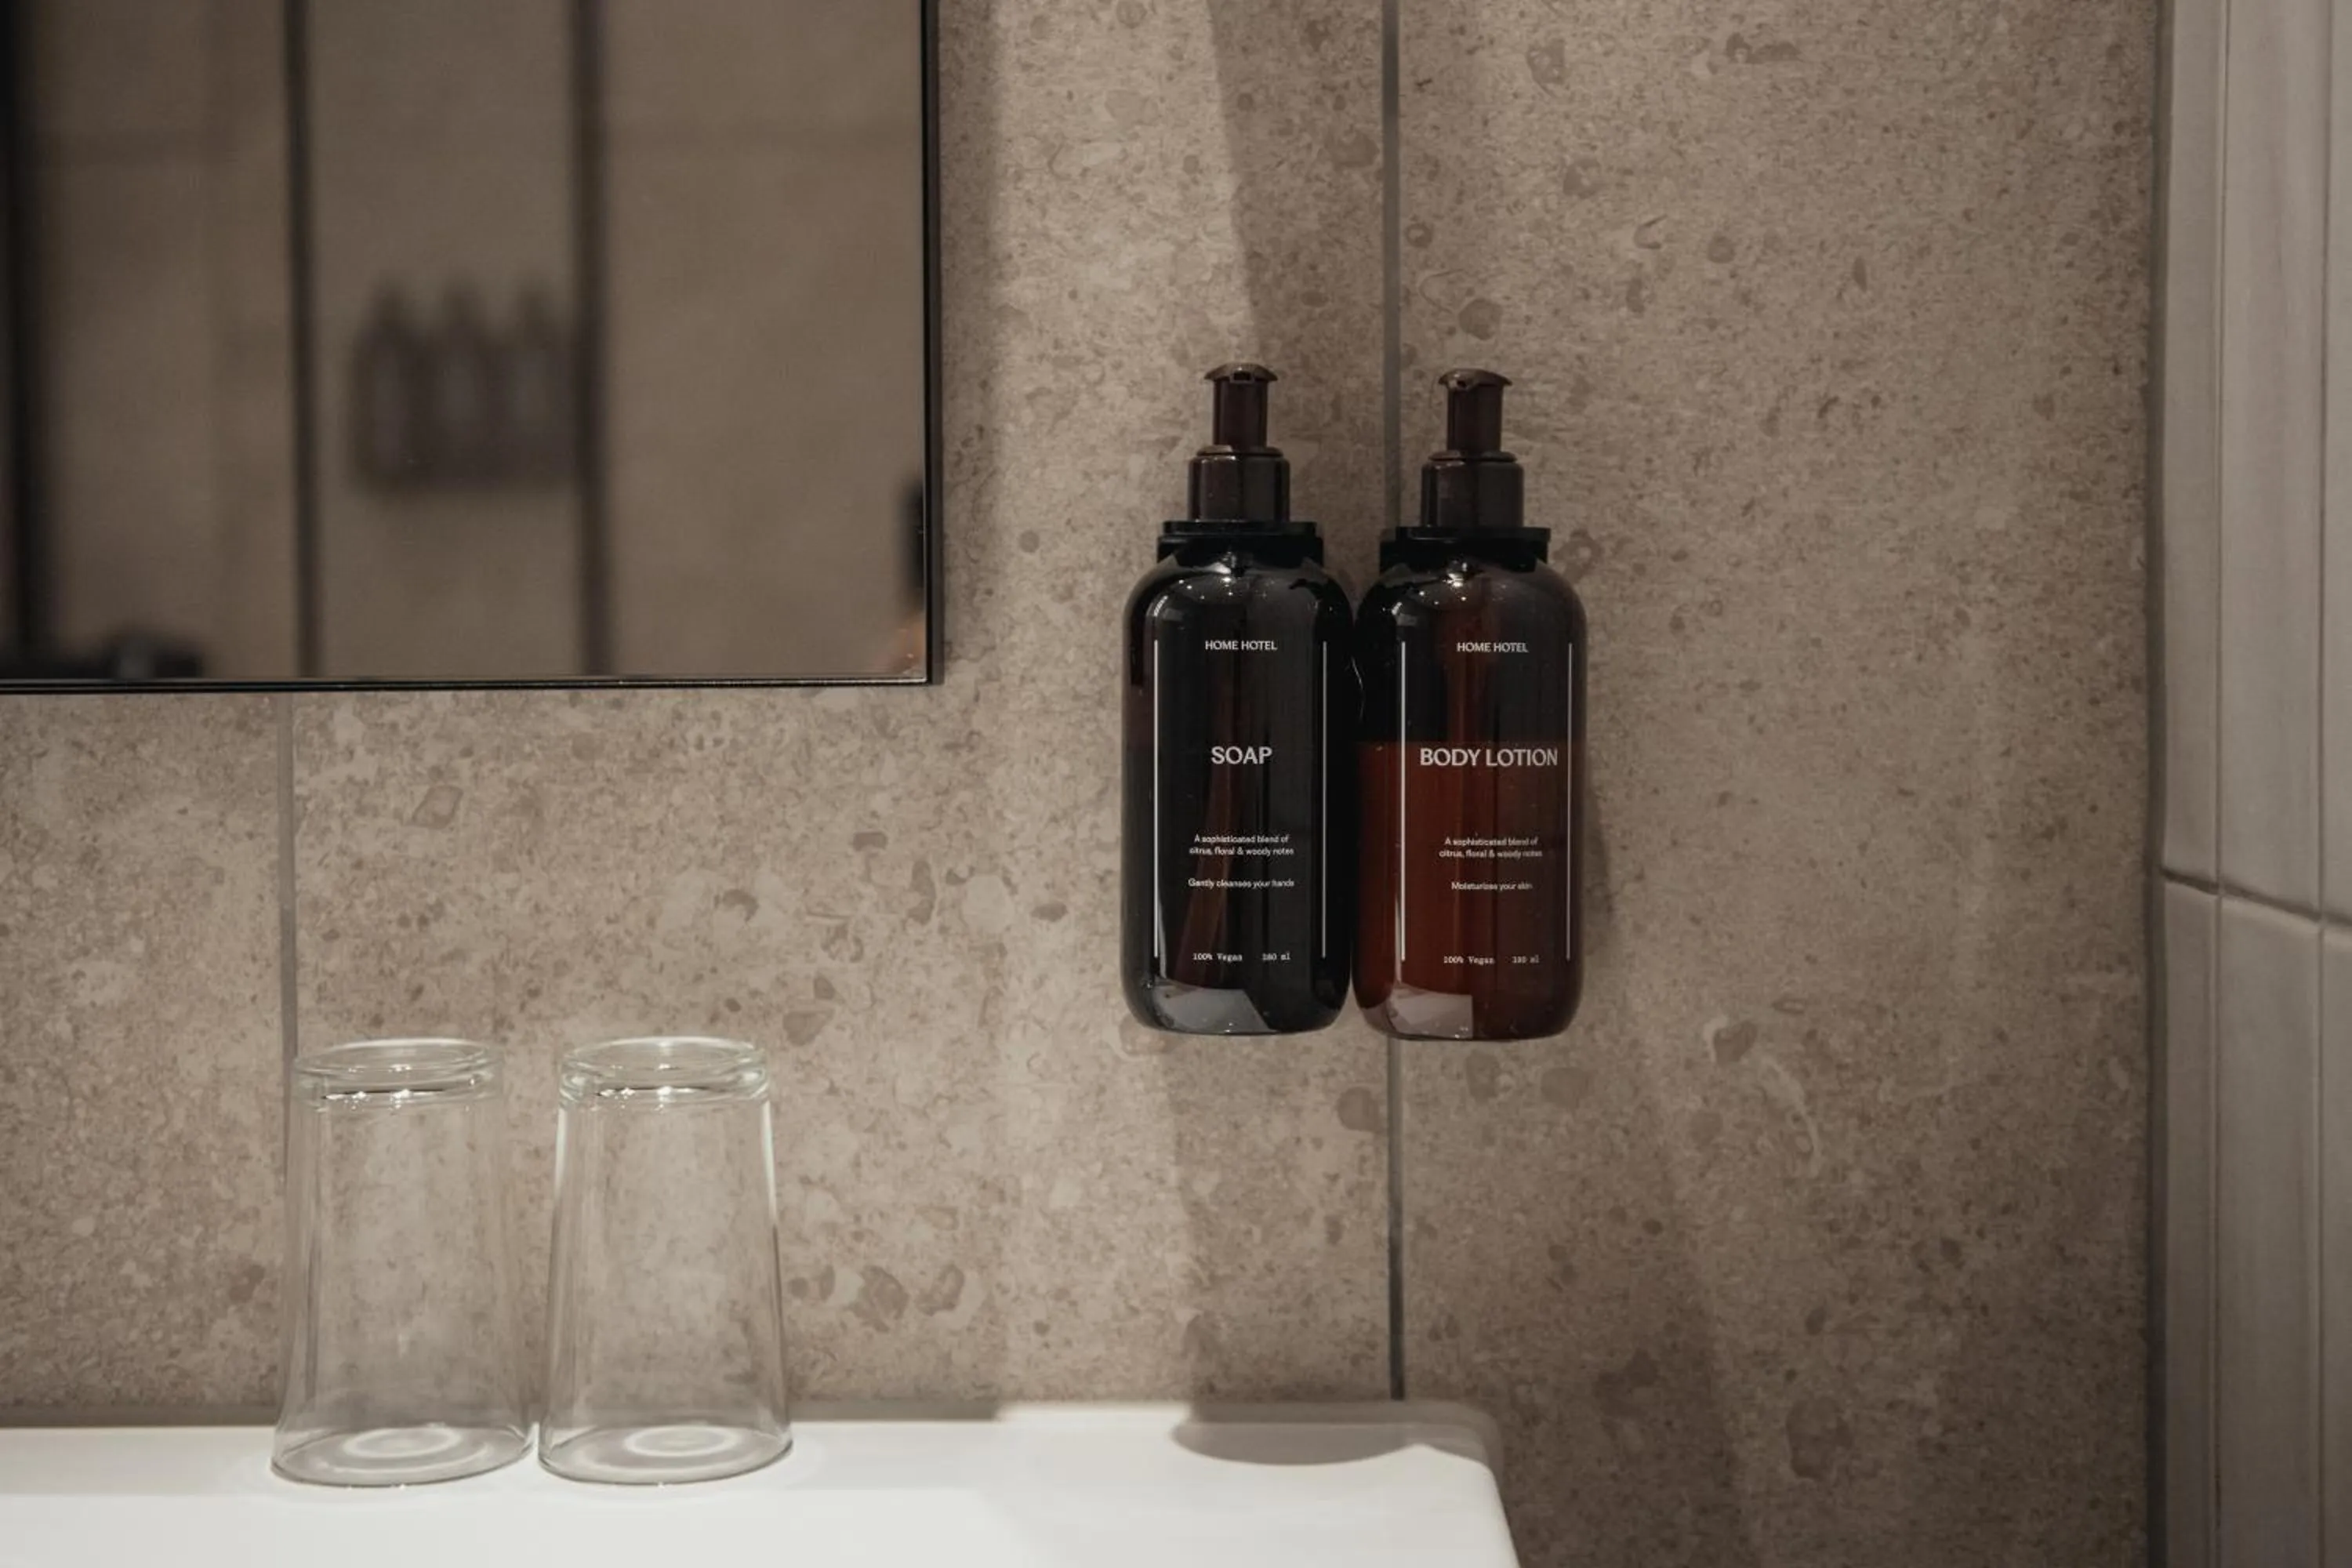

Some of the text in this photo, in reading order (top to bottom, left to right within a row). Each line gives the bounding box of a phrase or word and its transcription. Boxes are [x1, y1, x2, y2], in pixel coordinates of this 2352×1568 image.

[1205, 641, 1278, 651] HOME HOTEL
[1456, 642, 1529, 653] HOME HOTEL
[1210, 746, 1272, 764] SOAP
[1420, 748, 1559, 767] BODY LOTION
[1194, 834, 1200, 843] A
[1280, 834, 1290, 843] of
[1444, 837, 1451, 845] A
[1530, 837, 1539, 845] of
[1214, 847, 1235, 855] floral
[1246, 847, 1271, 857] woody
[1465, 849, 1487, 858] floral
[1188, 878, 1214, 889] Gently
[1253, 880, 1270, 889] your
[1499, 884, 1516, 892] your
[1217, 953, 1243, 963] Vegan
